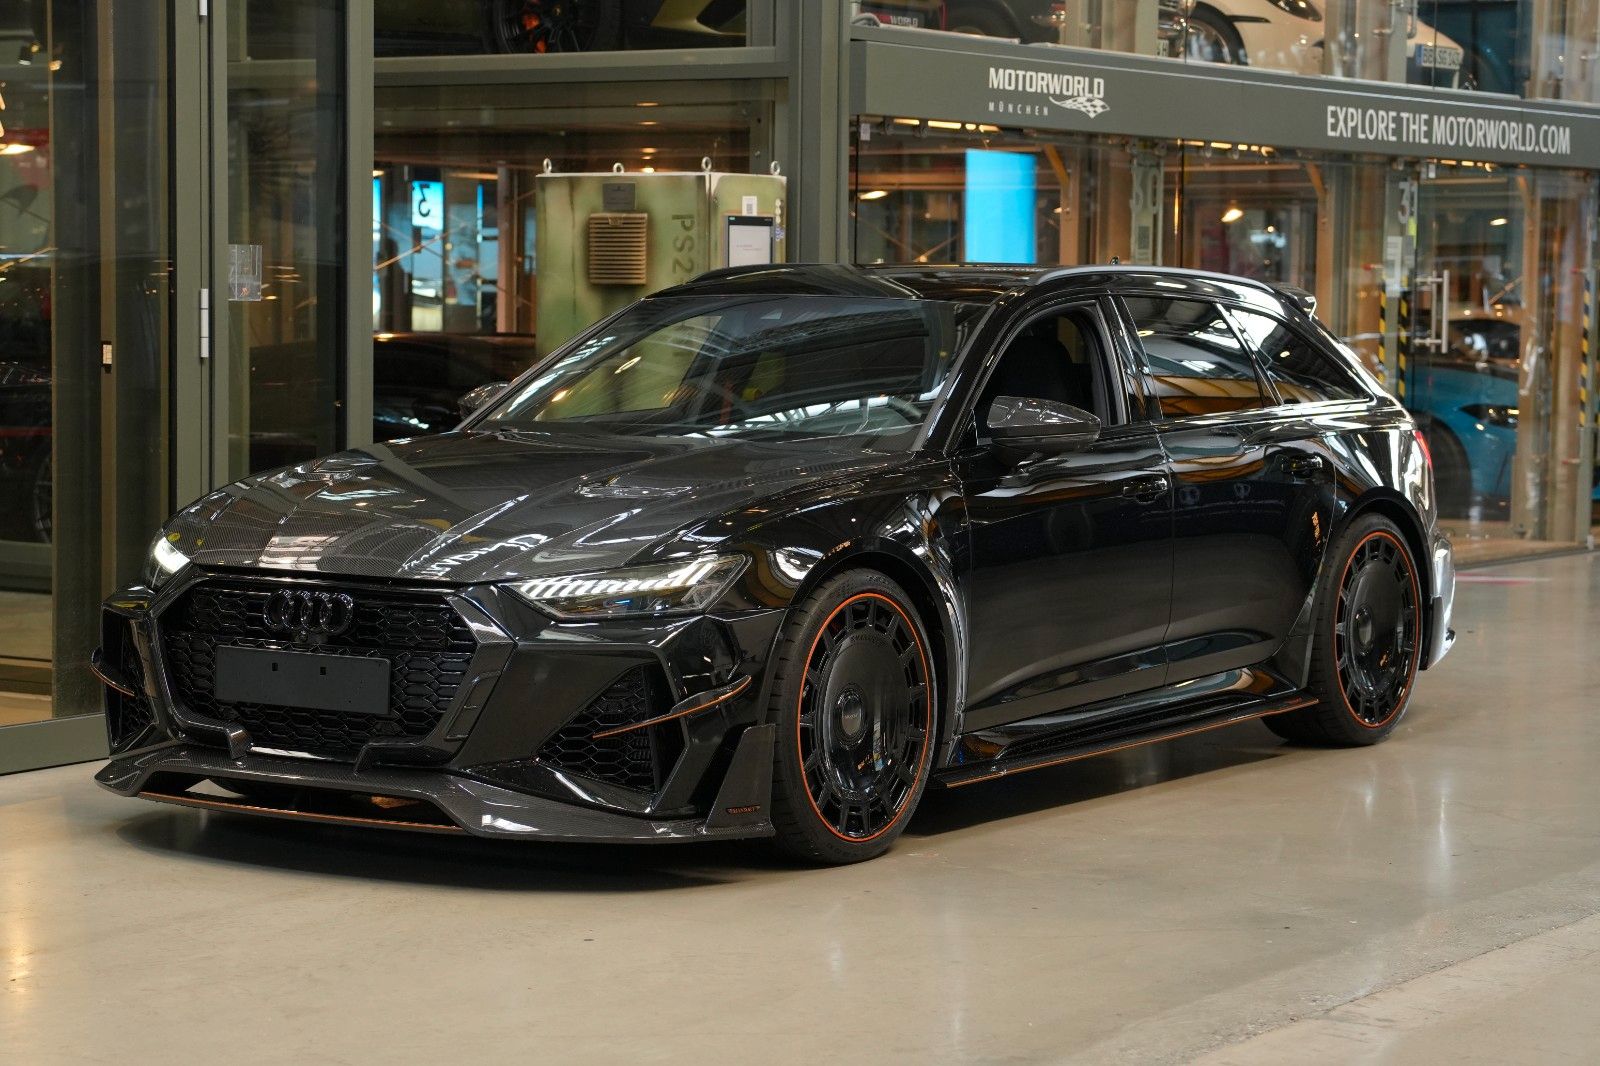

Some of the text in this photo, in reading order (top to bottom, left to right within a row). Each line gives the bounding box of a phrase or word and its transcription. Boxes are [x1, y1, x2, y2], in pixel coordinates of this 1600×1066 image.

[989, 67, 1104, 98] MOTORWORLD
[988, 101, 1048, 116] MÜNCHEN
[1327, 105, 1570, 155] EXPLORE THE MOTORWORLD.COM
